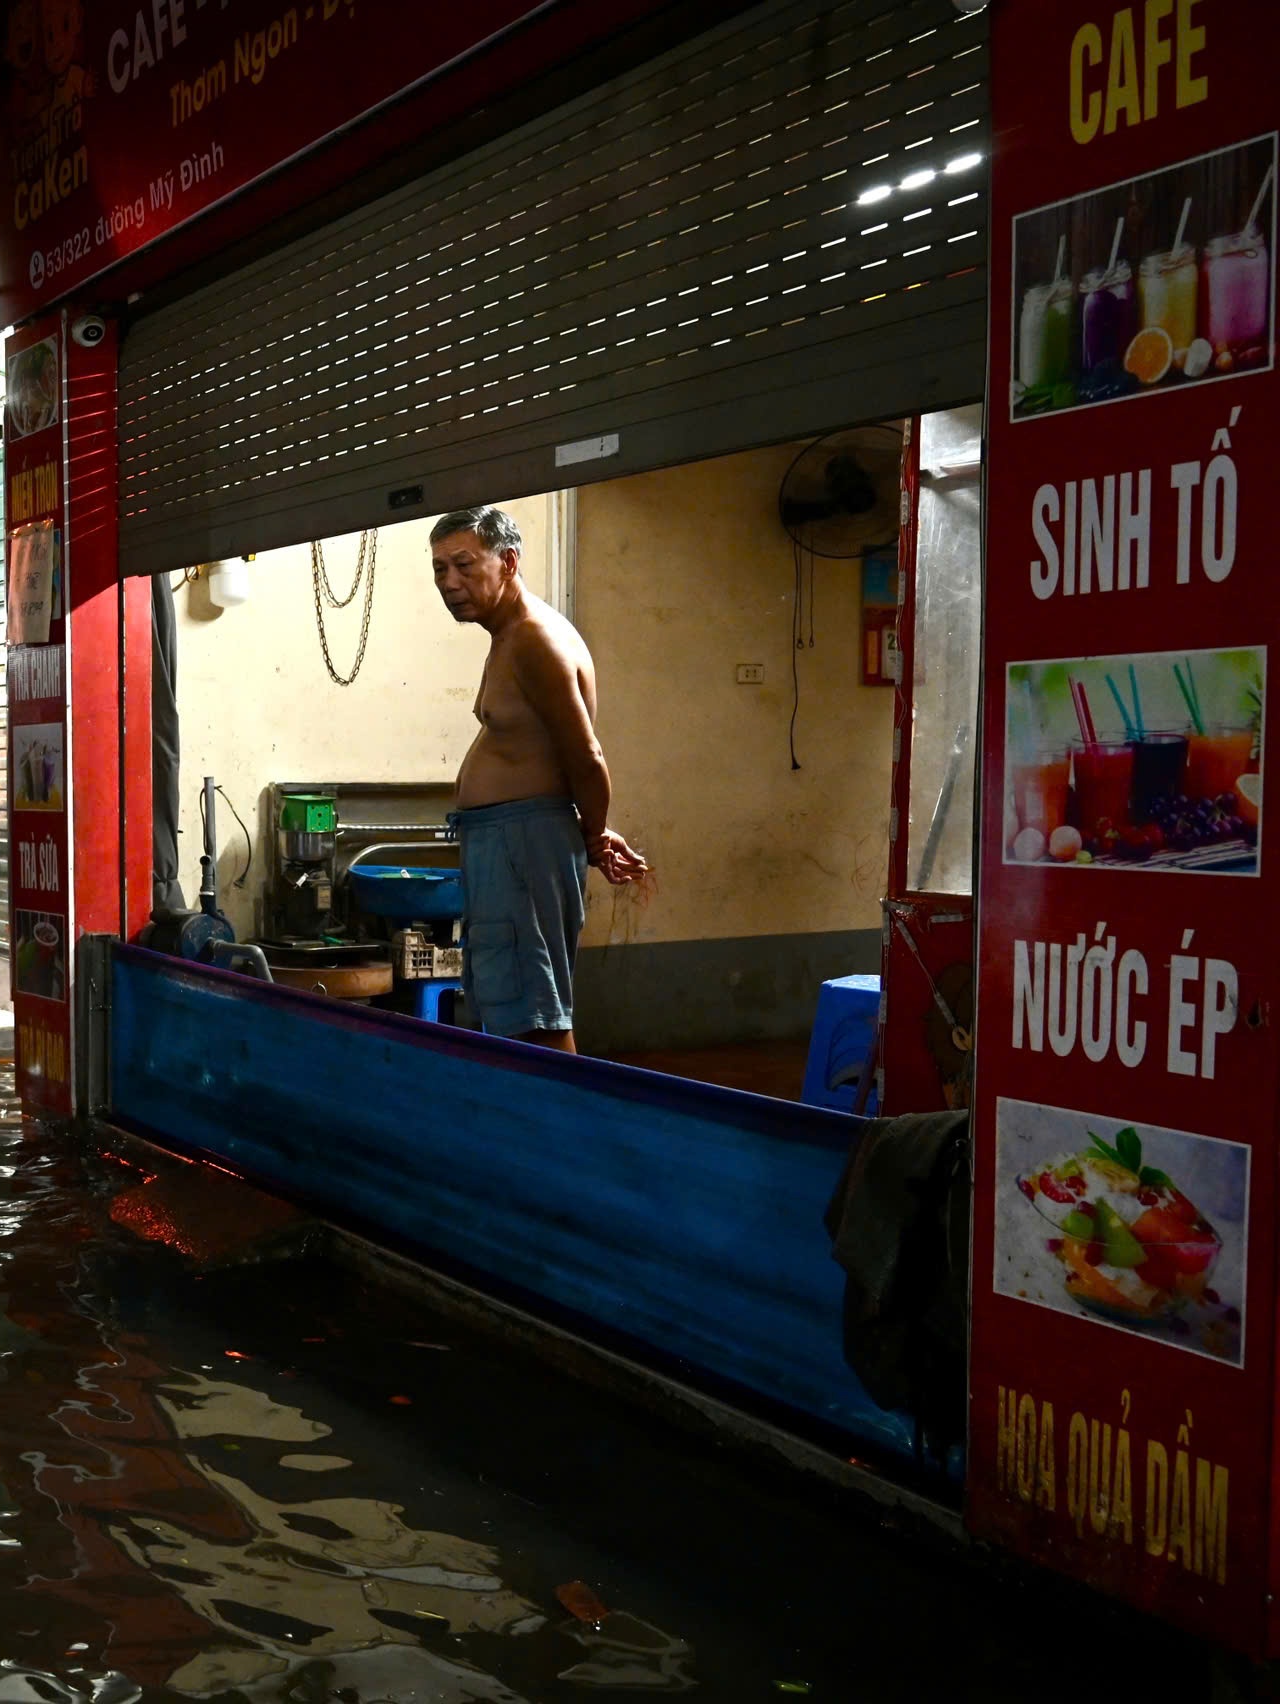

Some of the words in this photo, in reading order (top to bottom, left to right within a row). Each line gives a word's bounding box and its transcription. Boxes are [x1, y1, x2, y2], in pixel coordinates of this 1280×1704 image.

[170, 59, 227, 129] Thơm
[233, 7, 298, 86] Ngon
[14, 143, 88, 232] CaKen
[45, 227, 91, 279] 53/322
[94, 195, 145, 247] đường
[149, 168, 175, 213] Mỹ
[179, 140, 224, 193] Đình
[1029, 468, 1152, 600] SINH
[1169, 405, 1243, 585] TỐ
[31, 647, 61, 699] CHANH
[19, 831, 37, 889] TRÀ
[39, 833, 59, 892] SỮA
[1011, 920, 1150, 1069] NƯỚC
[1166, 928, 1240, 1081] ÉP
[997, 1384, 1057, 1513] HOA
[1065, 1387, 1133, 1545] QUẢ
[1144, 1408, 1230, 1587] DẦM
